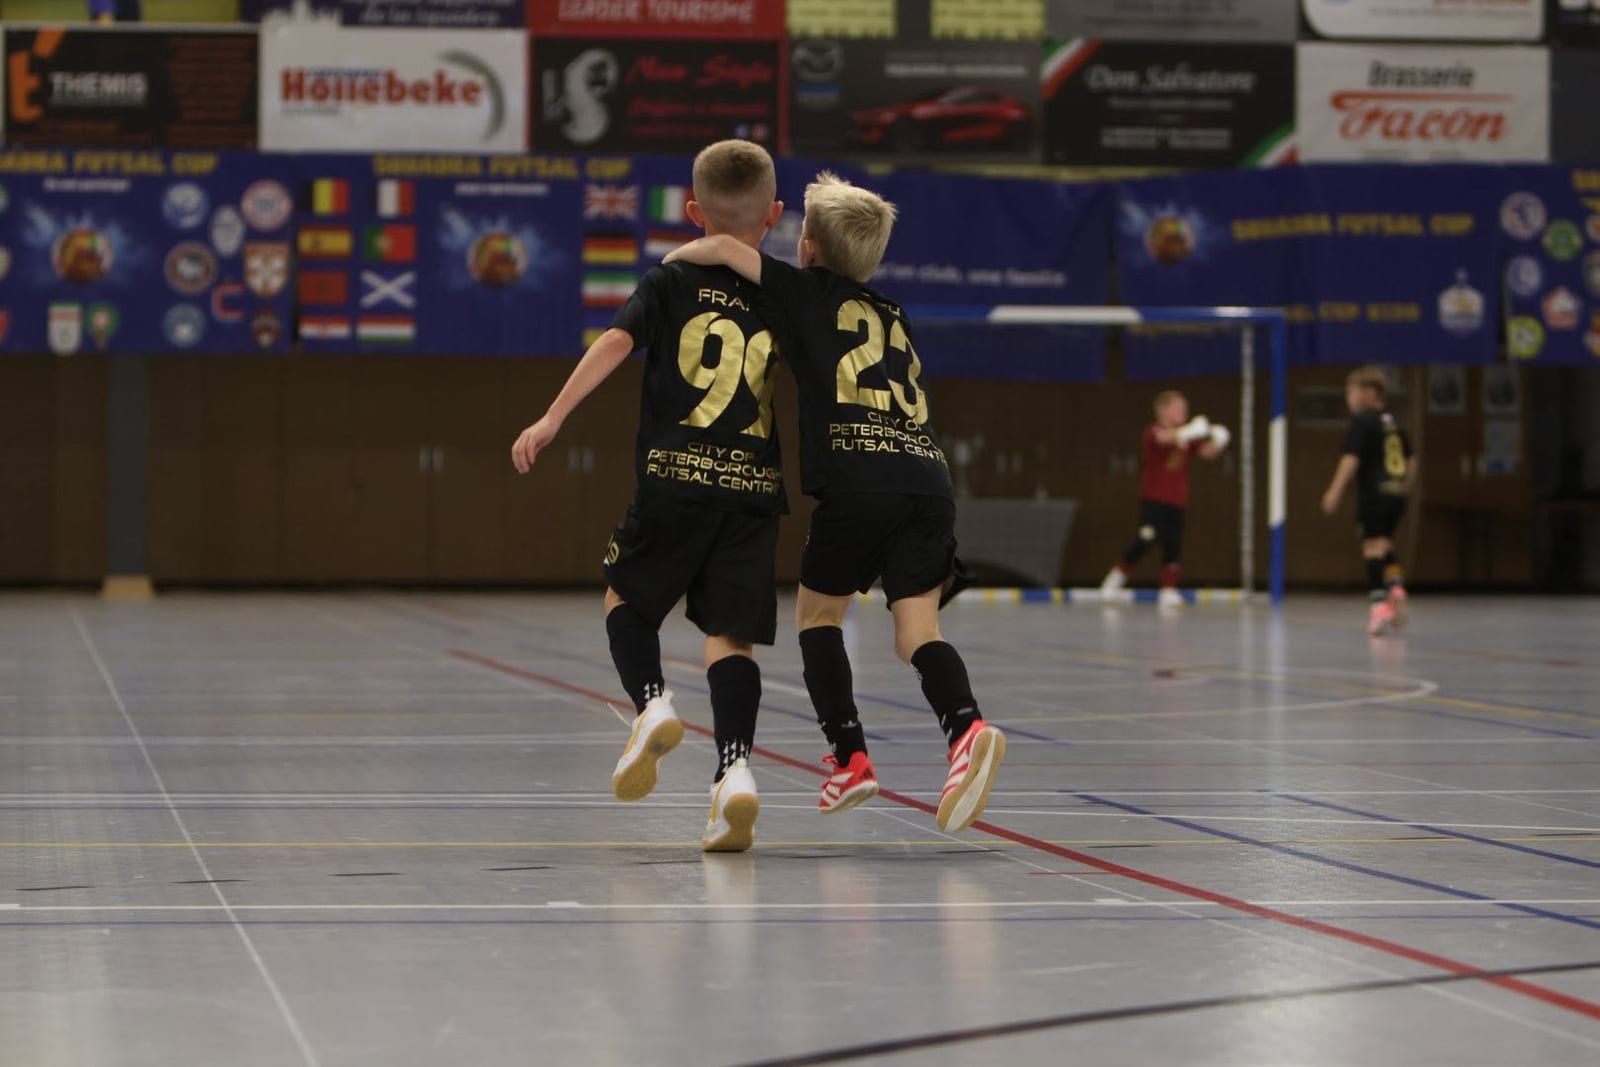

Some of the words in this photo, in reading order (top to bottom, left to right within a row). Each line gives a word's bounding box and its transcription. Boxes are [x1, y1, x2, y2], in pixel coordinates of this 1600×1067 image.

[646, 0, 754, 23] TOURISME
[50, 71, 149, 100] THEMIS
[1368, 60, 1475, 88] Brasserie
[0, 153, 67, 174] ADRA
[73, 153, 166, 174] FUTSAL
[172, 153, 218, 175] CUP
[488, 156, 579, 179] FUTSAL
[585, 157, 633, 179] CUP
[1337, 211, 1426, 238] FUTSAL
[1429, 212, 1476, 237] CUP
[698, 288, 751, 312] FRA
[836, 299, 929, 425] 23
[678, 311, 777, 439] 99
[867, 412, 900, 428] CITY
[905, 419, 923, 432] O
[829, 423, 938, 450] PETERBORO
[832, 439, 900, 453] FUTSAL
[687, 442, 727, 459] CITY
[730, 449, 756, 462] OF
[646, 463, 713, 486] FUTSAL
